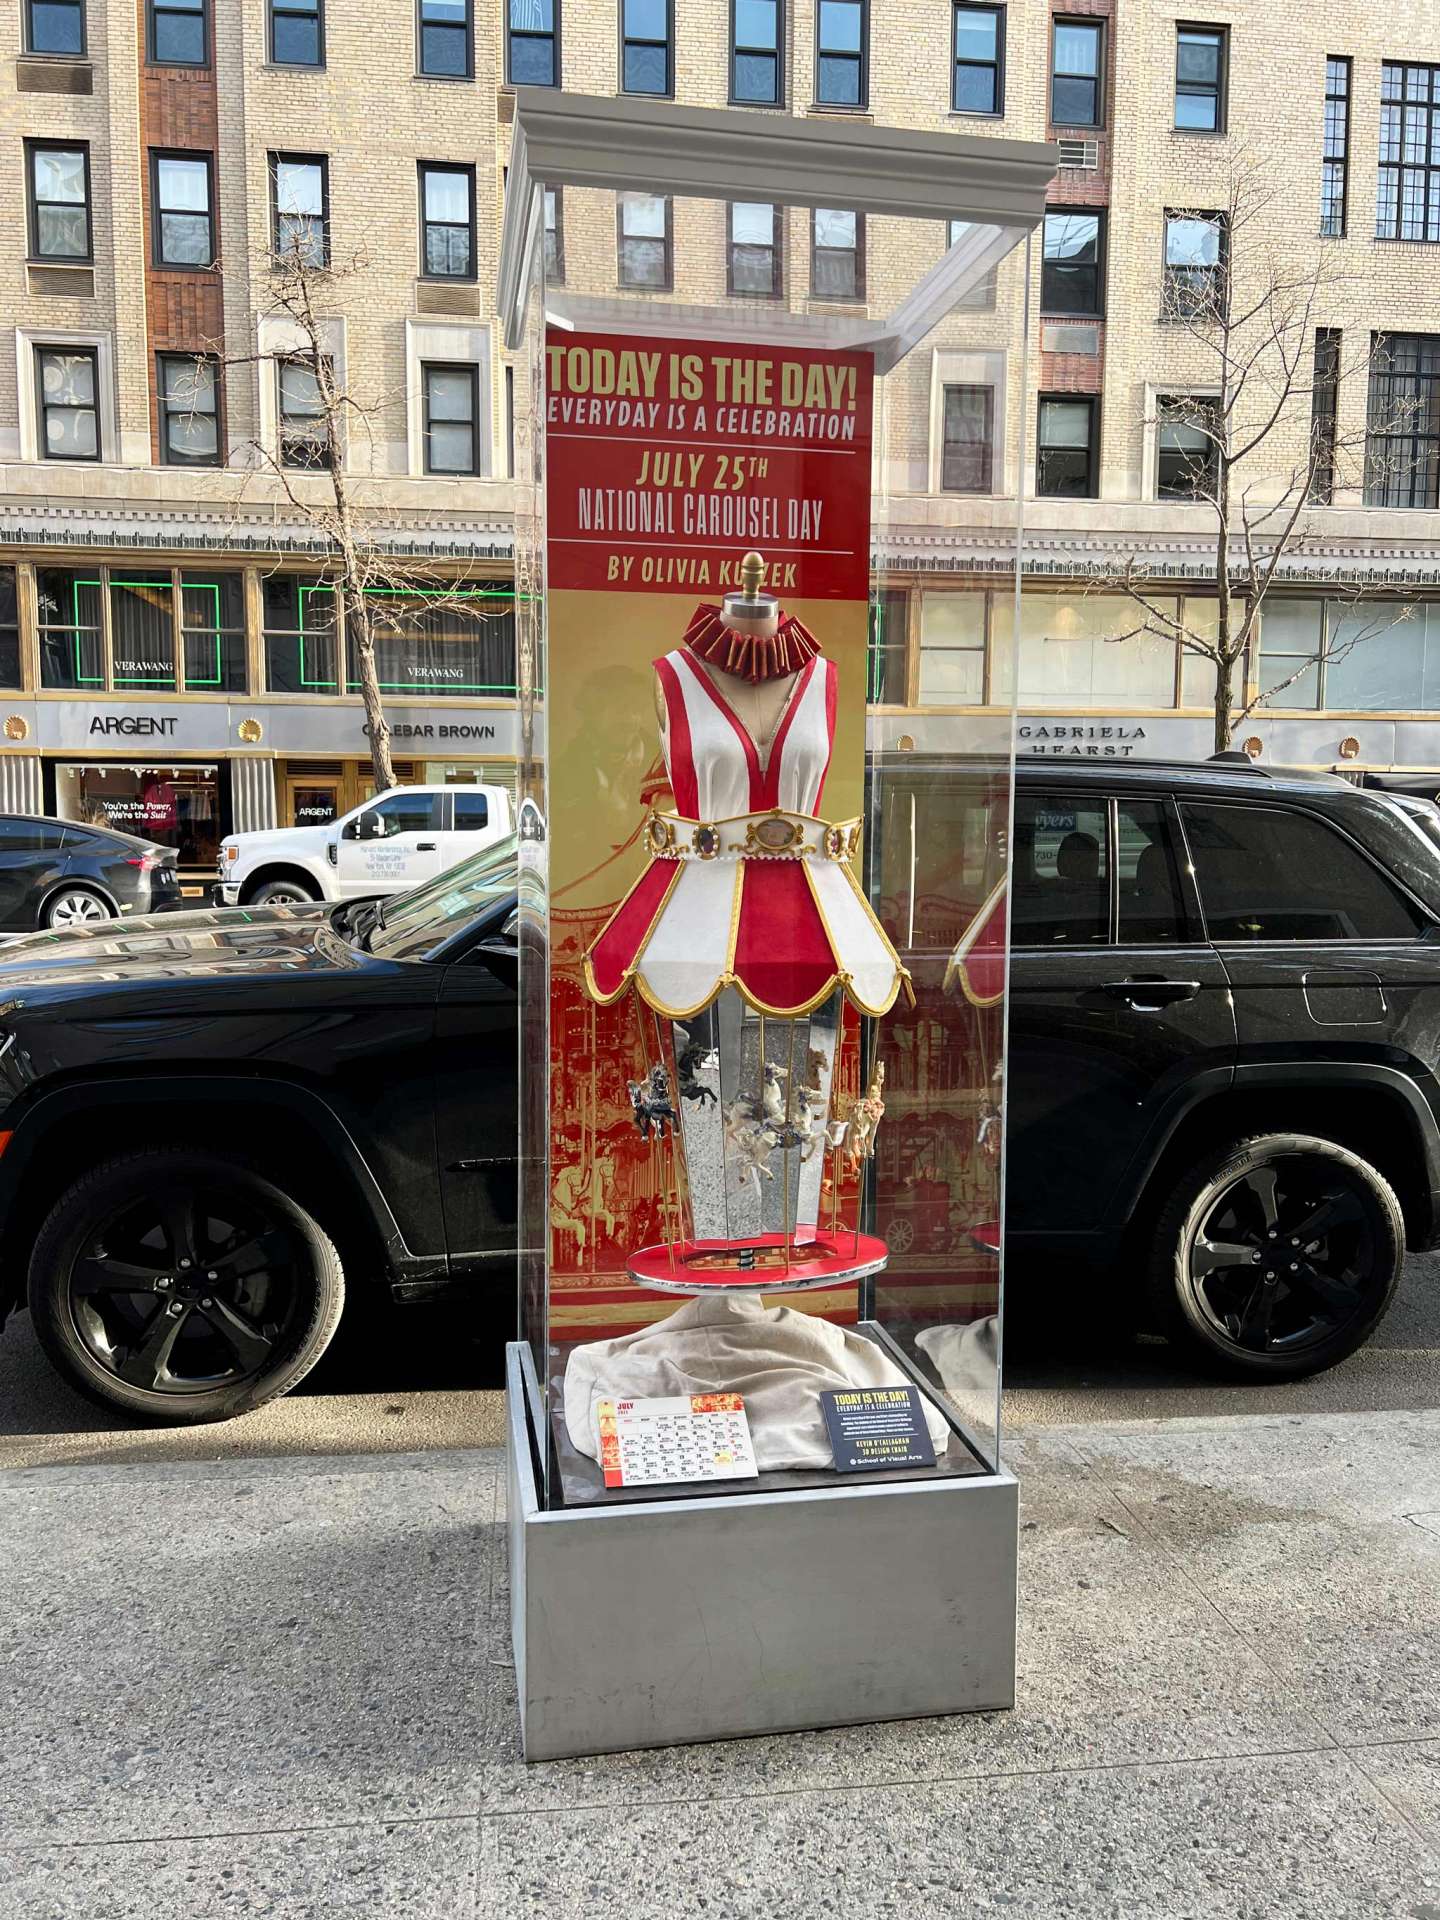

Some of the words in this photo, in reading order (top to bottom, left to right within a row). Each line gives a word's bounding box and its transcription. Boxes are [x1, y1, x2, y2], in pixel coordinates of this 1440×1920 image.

[546, 345, 661, 397] TODAY
[669, 353, 704, 401] IS
[711, 356, 773, 405] THE
[781, 361, 857, 411] DAY!
[547, 396, 661, 428] EVERYDAY
[667, 403, 686, 430] IS
[693, 405, 707, 432] A
[715, 407, 856, 441] CELEBRATION
[635, 451, 705, 488] JULY
[713, 455, 769, 491] 25TH
[578, 487, 675, 534] NATIONAL
[683, 493, 780, 539] CAROUSEL
[788, 498, 823, 540] DAY
[607, 555, 635, 581] BY
[641, 556, 710, 585] OLIVIA
[718, 560, 797, 588] KUZEK
[89, 716, 178, 735] ARGENT
[362, 723, 434, 737] EBAR
[438, 725, 495, 738] BROWN
[1019, 726, 1146, 738] GABRIELA
[1031, 745, 1133, 756] HEARST
[102, 801, 129, 810] You're
[130, 802, 145, 810] the
[146, 802, 172, 812] Power,
[299, 807, 334, 816] ARGENT
[108, 811, 133, 819] We're
[134, 811, 149, 819] the
[150, 810, 167, 819] Suit
[833, 1393, 861, 1406] TODAY
[862, 1392, 872, 1404] IS
[871, 1391, 889, 1403] THE
[888, 1390, 910, 1402] DAY!
[617, 1402, 634, 1410] JULY
[836, 1404, 863, 1413] EVERYDAY
[876, 1401, 911, 1410] CELEBRATION
[856, 1440, 873, 1448] KEVIN
[870, 1447, 890, 1455] DESIGN
